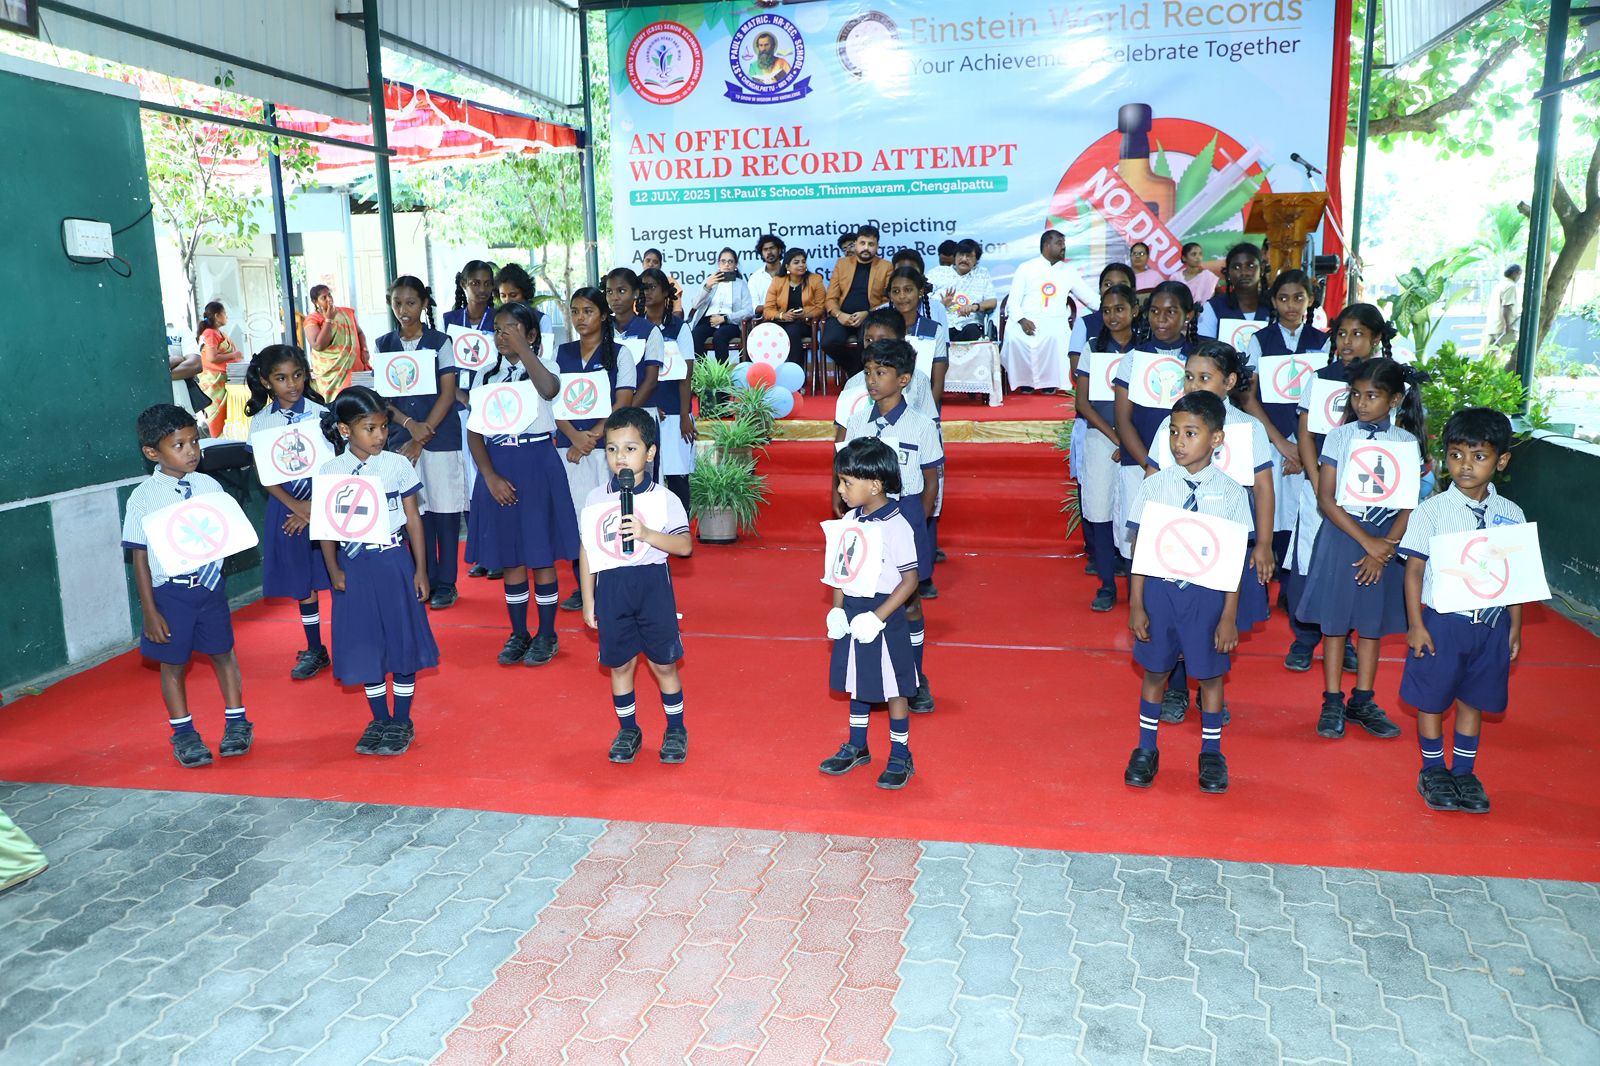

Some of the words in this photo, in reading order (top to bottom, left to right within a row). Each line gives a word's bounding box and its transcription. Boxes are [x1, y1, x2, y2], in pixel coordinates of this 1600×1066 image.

[910, 11, 1037, 44] Einstein
[1163, 0, 1304, 28] Records
[731, 32, 743, 60] PAUL'S
[794, 39, 804, 70] SCHOOL
[911, 57, 955, 75] Your
[1204, 36, 1301, 63] Together
[628, 132, 666, 155] AN
[674, 125, 811, 153] OFFICIAL
[629, 156, 733, 182] WORLD
[741, 150, 863, 177] RECORD
[871, 143, 1018, 172] ATTEMPT
[635, 192, 648, 203] 12
[650, 191, 681, 203] JULY,
[683, 189, 711, 201] 2025
[720, 187, 766, 200] St.Paul's
[769, 185, 815, 198] Schools
[1084, 167, 1132, 216] NO
[631, 225, 694, 244] Largest
[698, 224, 763, 240] Human
[768, 221, 861, 237] Formation
[805, 243, 841, 259] with
